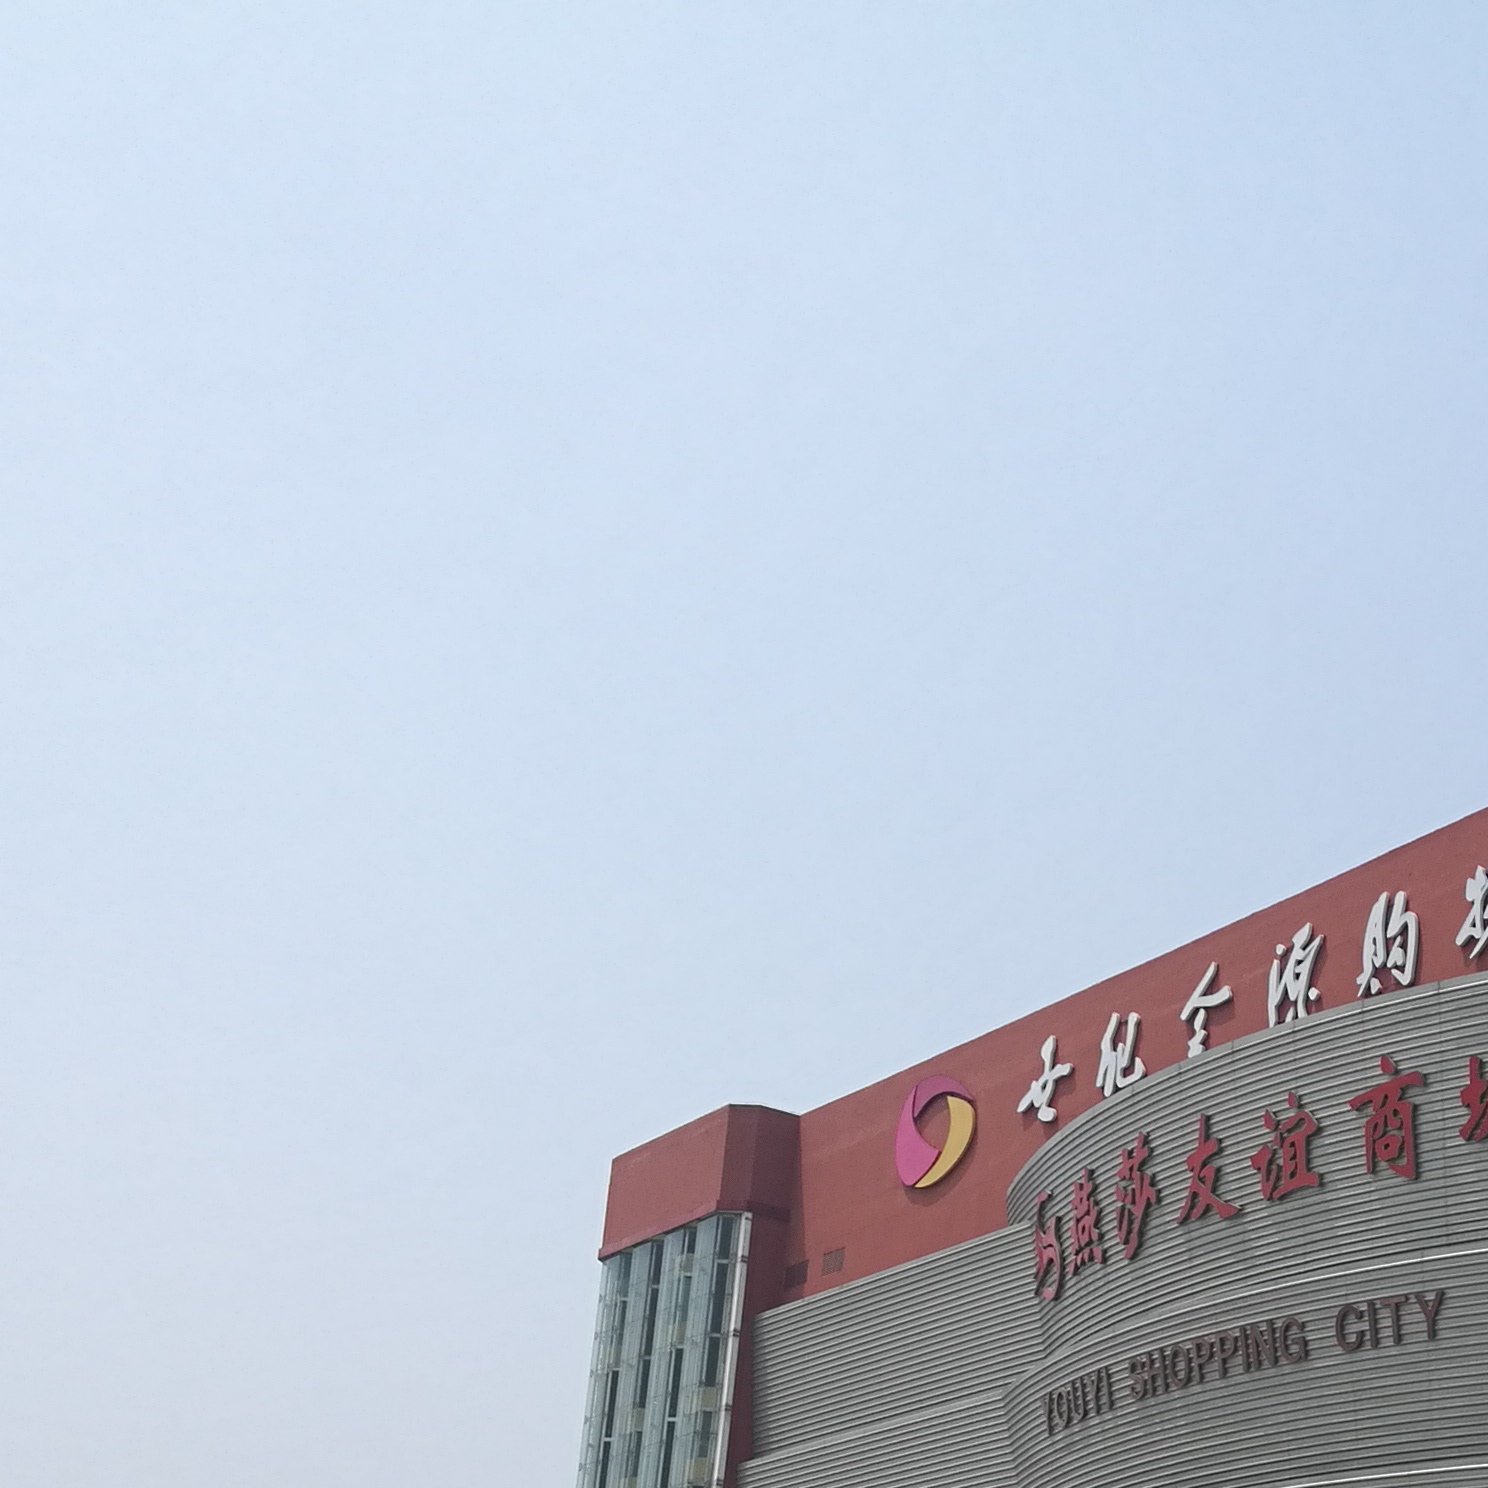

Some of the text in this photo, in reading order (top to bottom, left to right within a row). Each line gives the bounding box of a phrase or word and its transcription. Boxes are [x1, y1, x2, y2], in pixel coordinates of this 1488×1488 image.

[1042, 1289, 1446, 1437] YOUYI SHOPPING CITY
